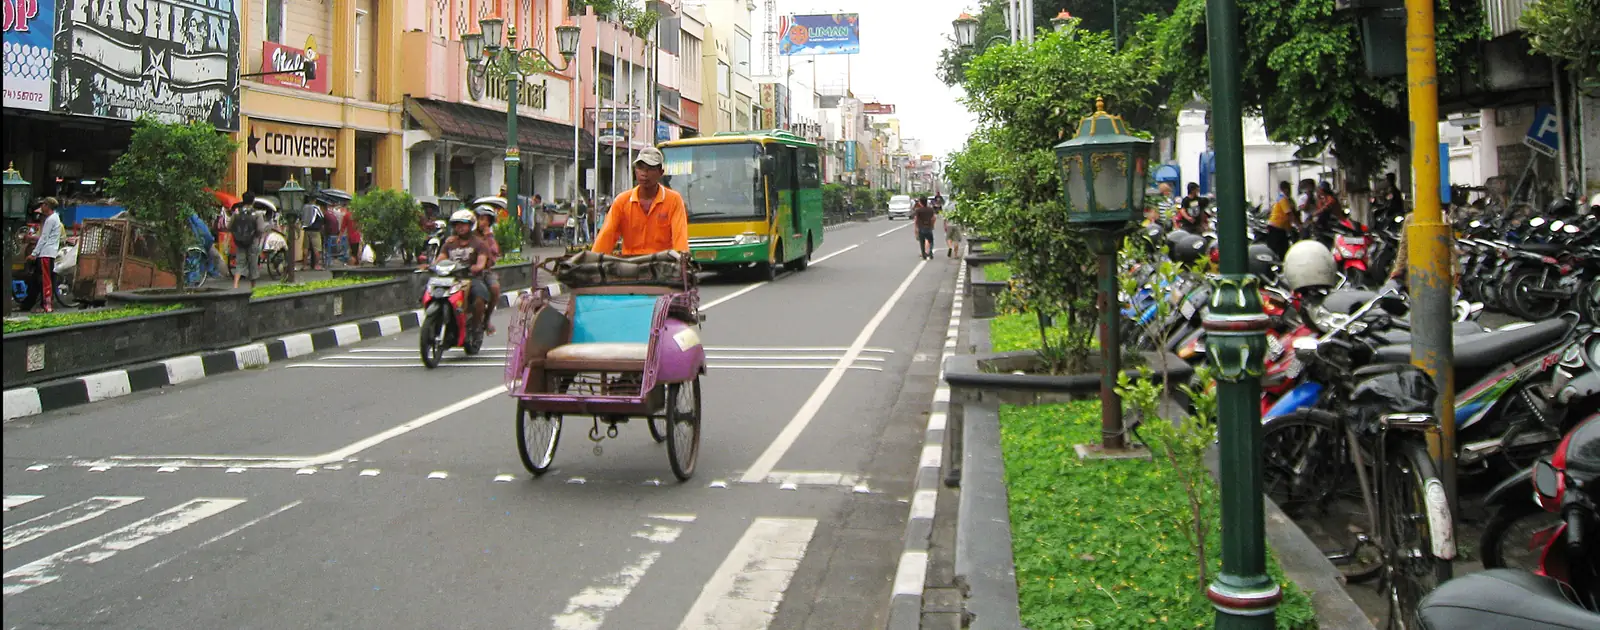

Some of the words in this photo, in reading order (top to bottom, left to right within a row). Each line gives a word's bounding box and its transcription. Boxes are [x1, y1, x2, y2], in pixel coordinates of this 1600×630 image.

[808, 26, 849, 38] LIMAN
[485, 67, 547, 110] maahari
[1537, 113, 1558, 138] P
[265, 132, 335, 158] CONVERSE
